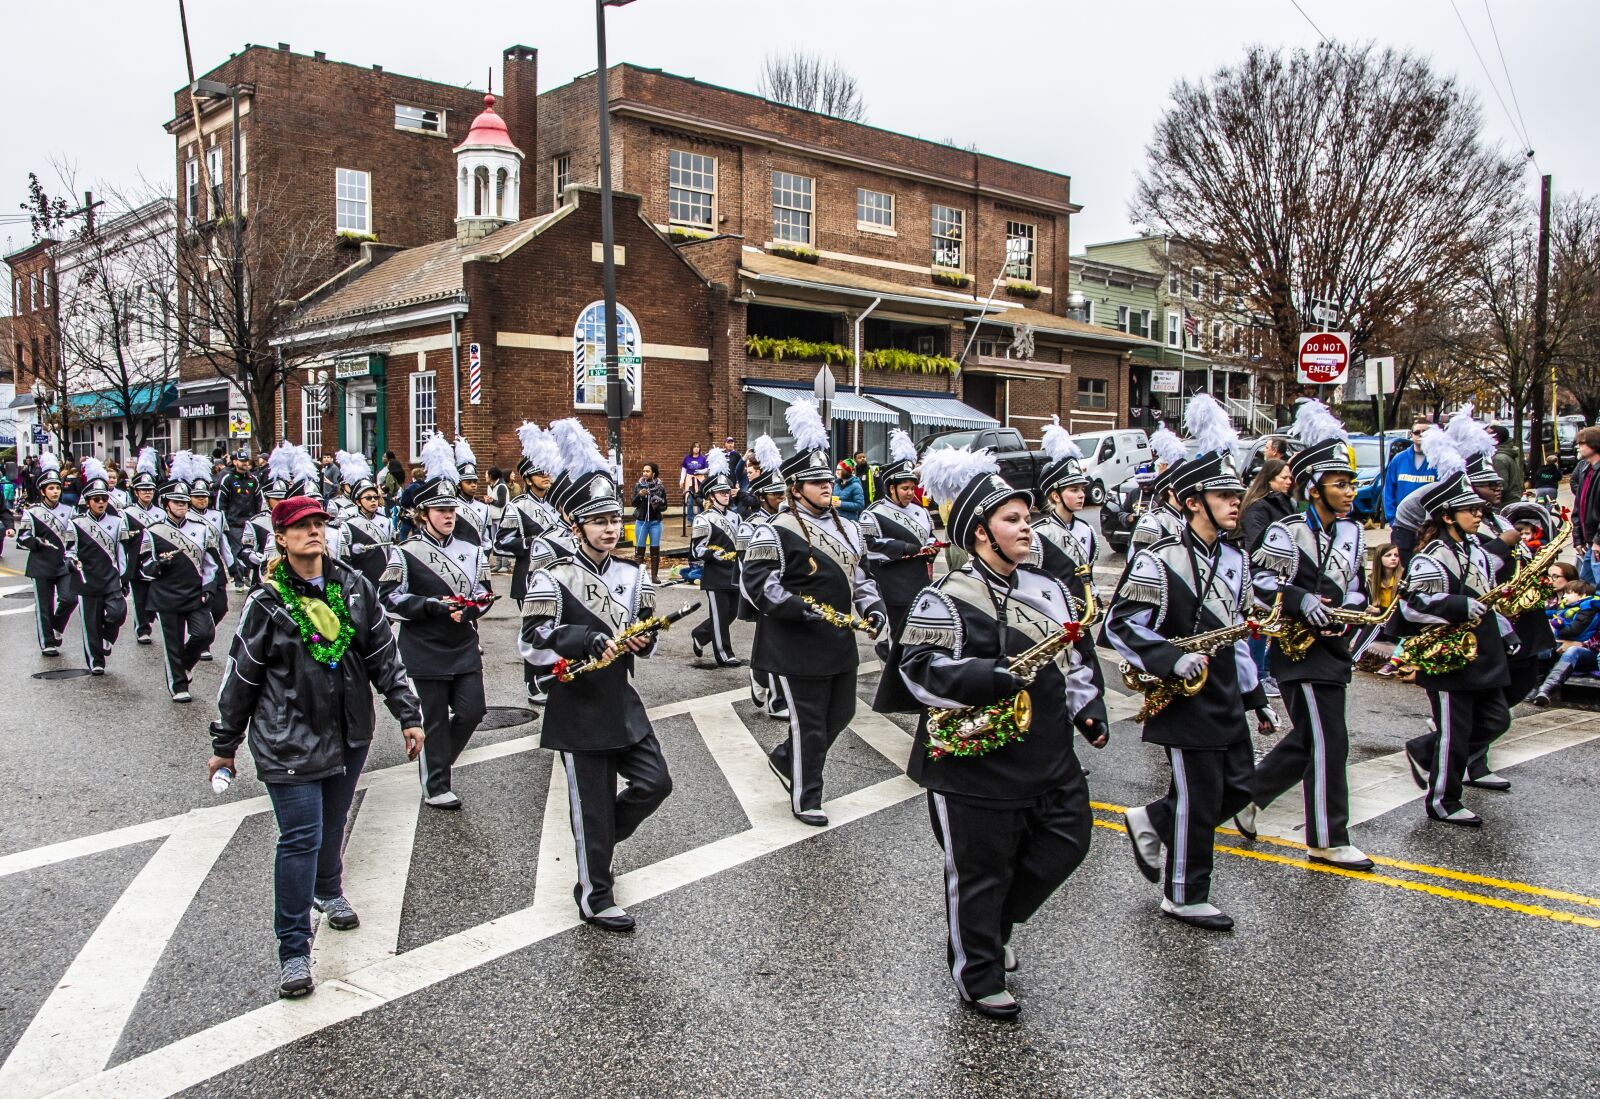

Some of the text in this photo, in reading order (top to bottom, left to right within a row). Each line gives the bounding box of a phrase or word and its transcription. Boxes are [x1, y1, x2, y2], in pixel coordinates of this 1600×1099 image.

[1306, 343, 1342, 352] DO NOT
[1308, 364, 1337, 374] ENTER
[179, 403, 215, 418] The Lunch Box
